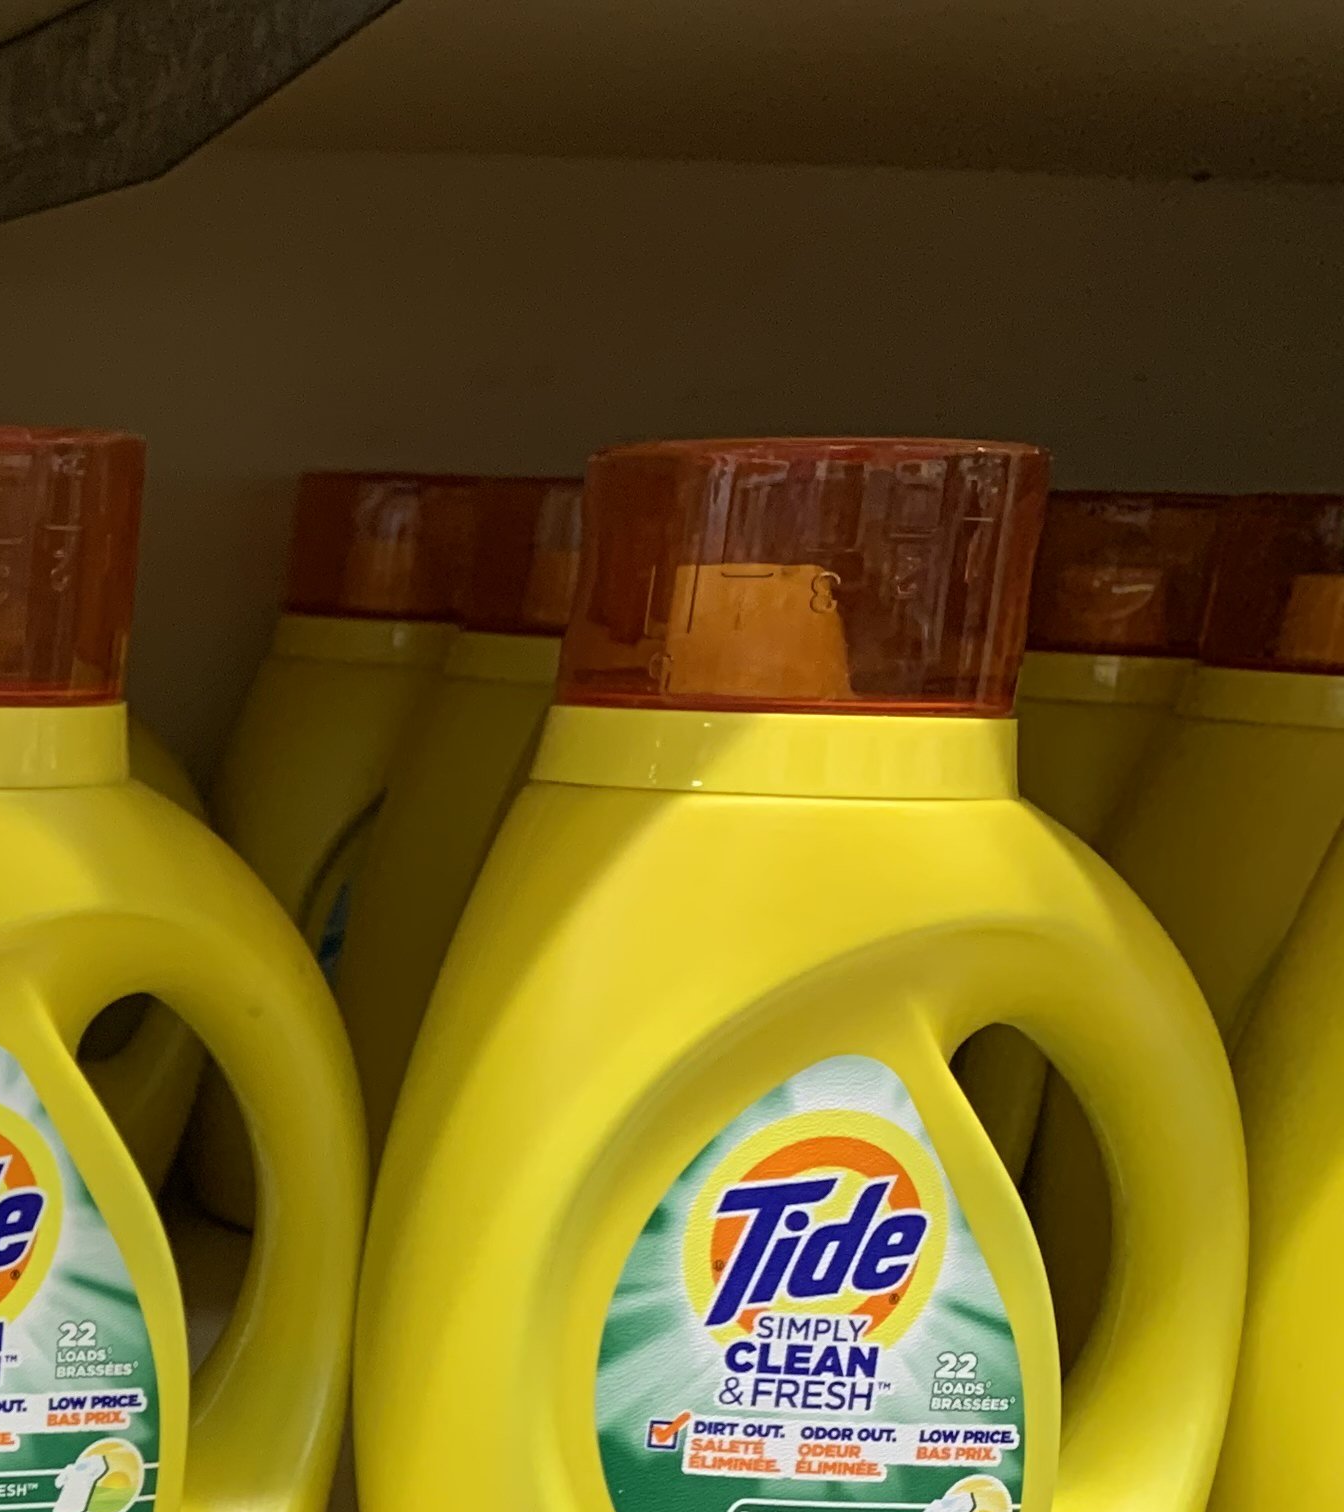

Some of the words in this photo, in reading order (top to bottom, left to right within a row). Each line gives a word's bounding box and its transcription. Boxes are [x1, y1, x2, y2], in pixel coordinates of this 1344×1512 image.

[705, 1178, 927, 1326] Tide
[57, 1321, 97, 1348] 22
[757, 1316, 869, 1342] SIMPLY
[724, 1341, 880, 1378] CLEAN
[935, 1352, 978, 1380] 22
[718, 1377, 744, 1406] &
[801, 1427, 853, 1442] ODOR
[857, 1428, 897, 1443] OUT.
